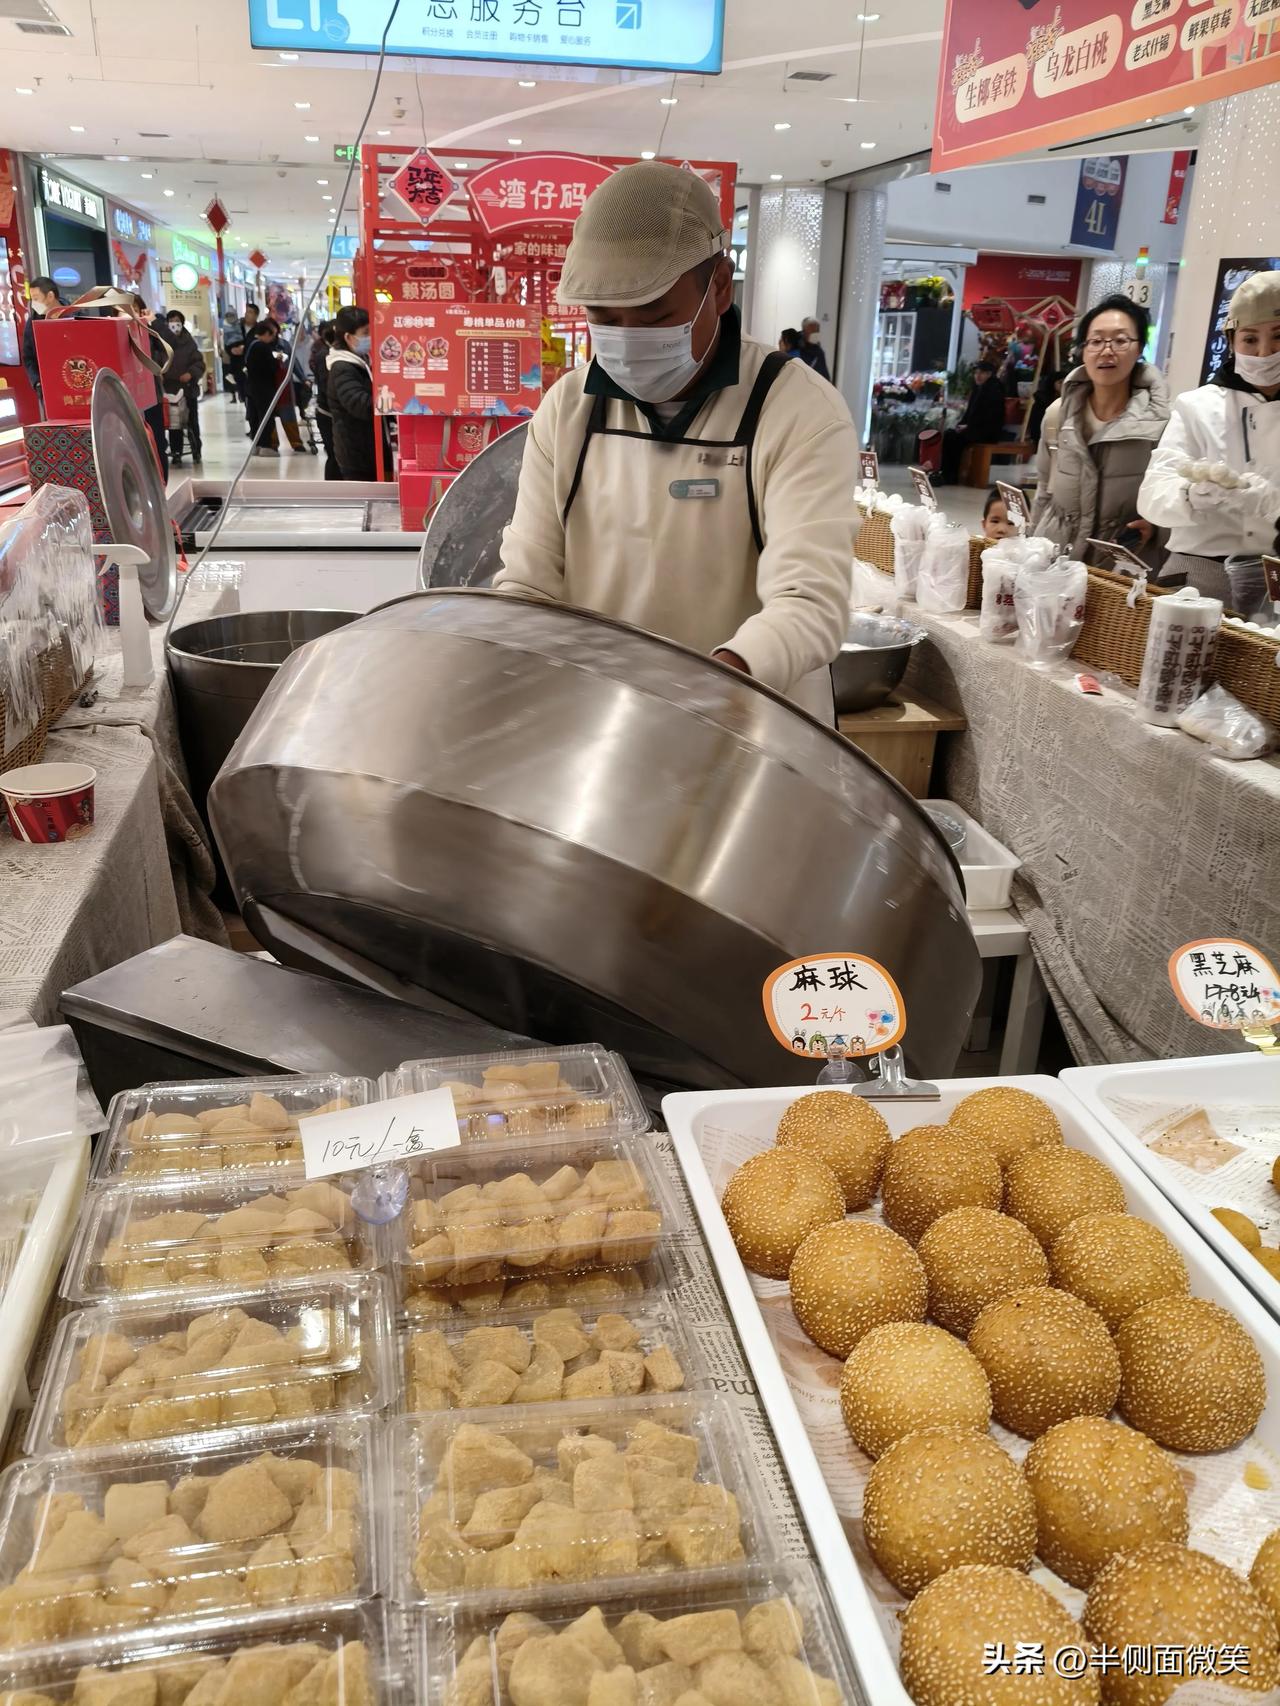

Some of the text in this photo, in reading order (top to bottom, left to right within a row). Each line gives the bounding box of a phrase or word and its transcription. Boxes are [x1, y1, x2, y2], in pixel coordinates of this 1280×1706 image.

[466, 29, 498, 41] 会员注册
[509, 32, 549, 44] 购物卡销售
[560, 34, 592, 46] 爱心服务
[1187, 8, 1233, 42] 鲜果草莓
[1044, 30, 1110, 83] 乌龙白桃
[1133, 33, 1170, 62] 老式什锦
[964, 66, 1018, 111] 生椰拿铁
[499, 179, 601, 210] 湾仔码
[1084, 199, 1107, 236] 4L
[514, 241, 567, 258] 家的味道
[402, 282, 455, 300] 赖汤圆
[789, 960, 868, 992] 麻球
[1189, 951, 1260, 978] 黑芝麻
[800, 1002, 846, 1024] 2元/个
